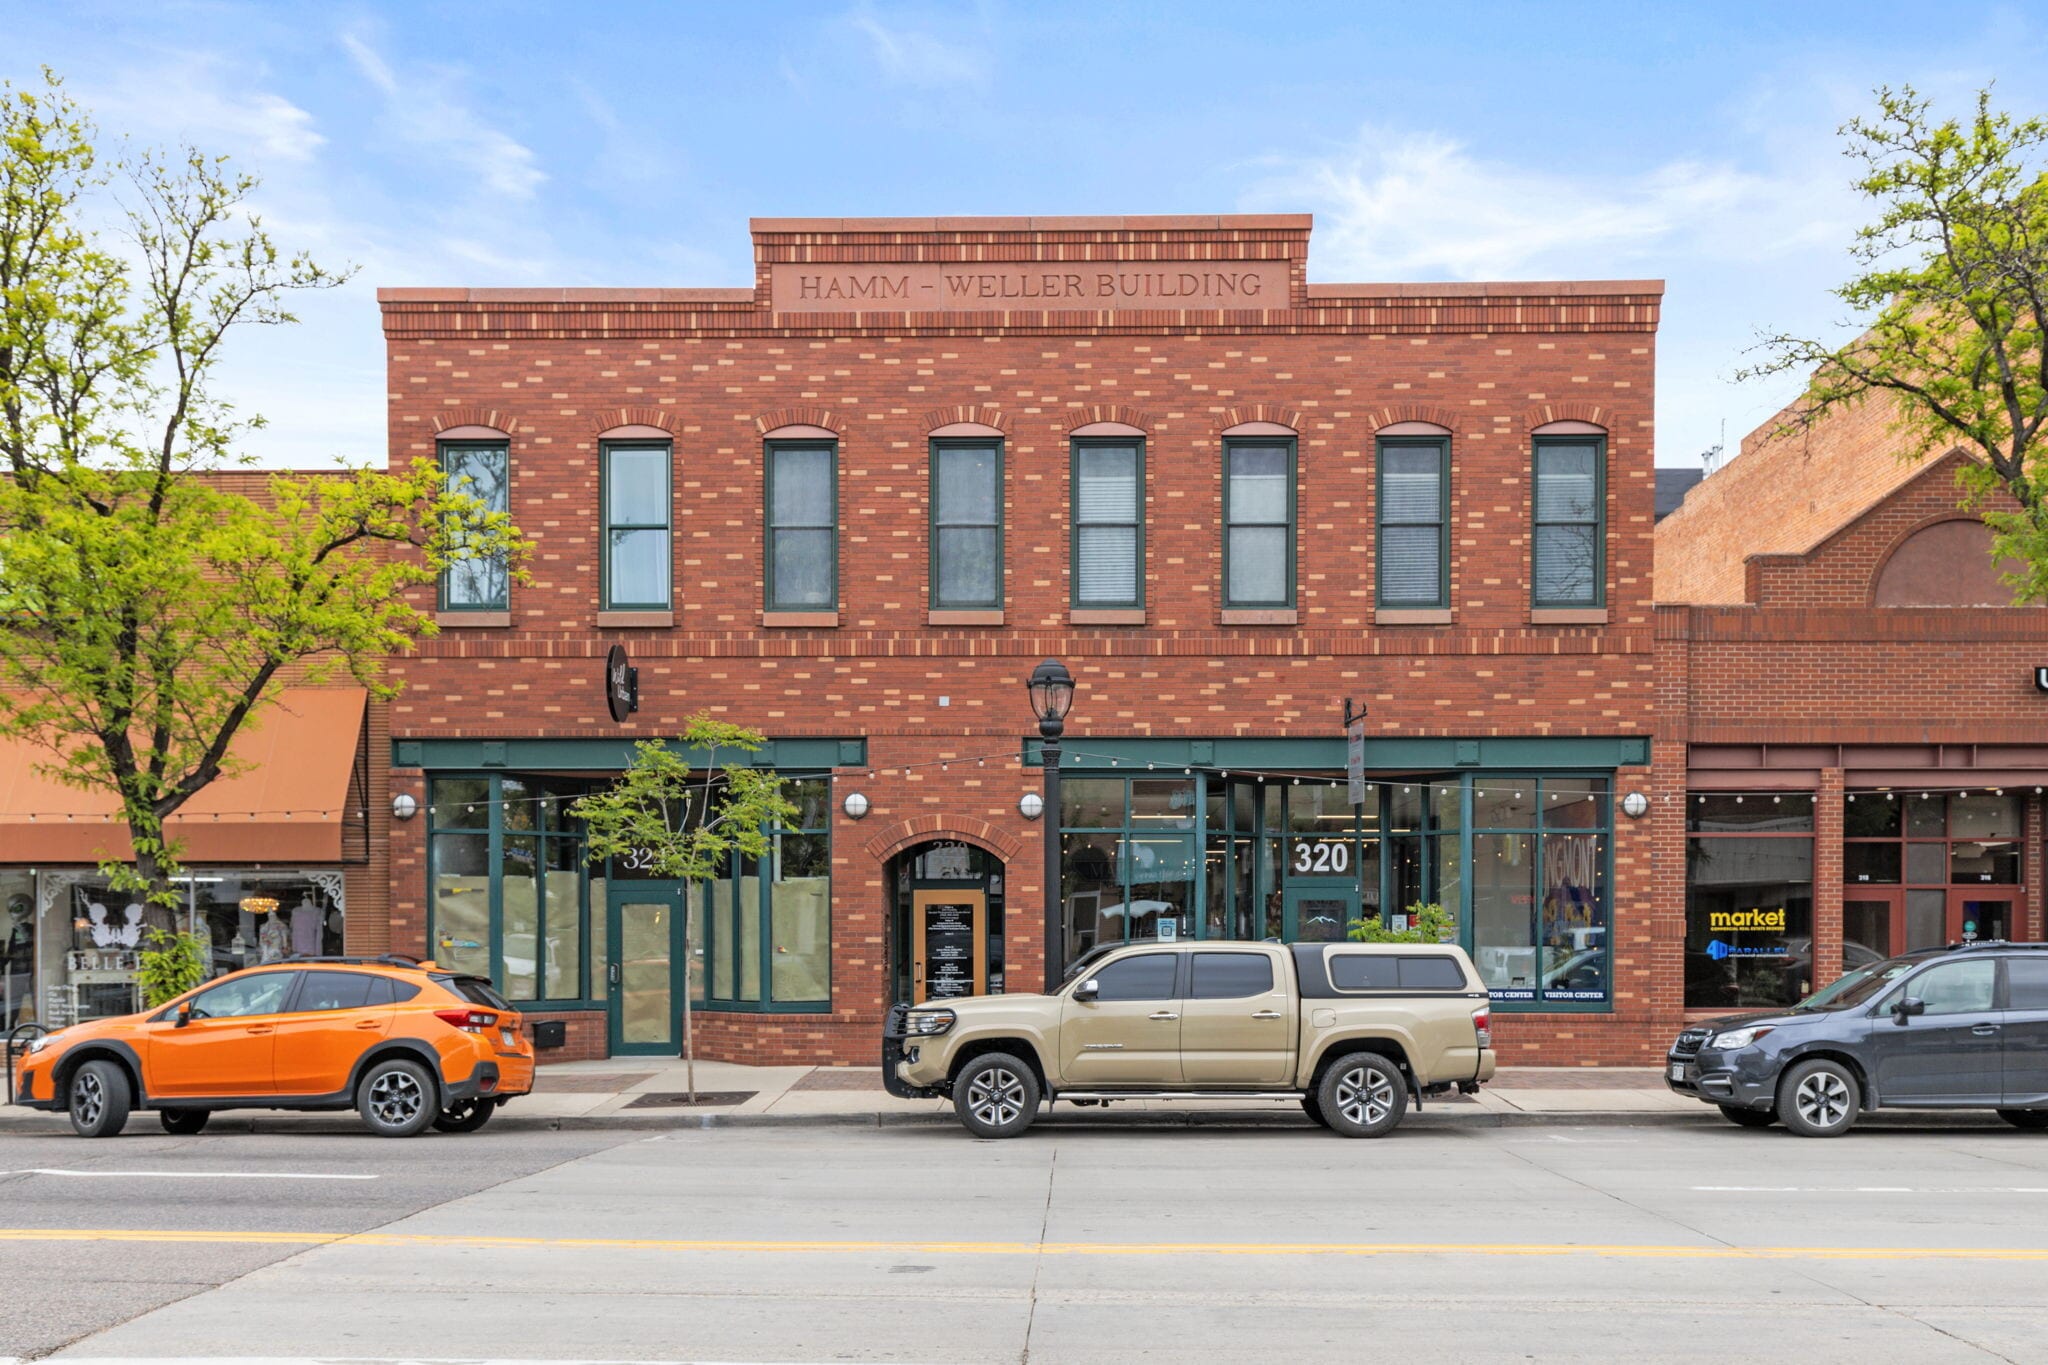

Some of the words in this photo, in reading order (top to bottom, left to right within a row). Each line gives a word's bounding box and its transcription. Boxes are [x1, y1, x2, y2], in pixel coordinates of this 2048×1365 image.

[800, 275, 910, 300] HAMM
[944, 274, 1085, 298] WELLER
[1096, 273, 1262, 297] BUILDING
[1295, 842, 1348, 872] 320
[1710, 908, 1785, 926] market
[68, 956, 124, 970] BELLE
[1505, 991, 1534, 999] CENTER
[1544, 991, 1574, 999] VISITOR
[1576, 991, 1604, 999] CENTER
